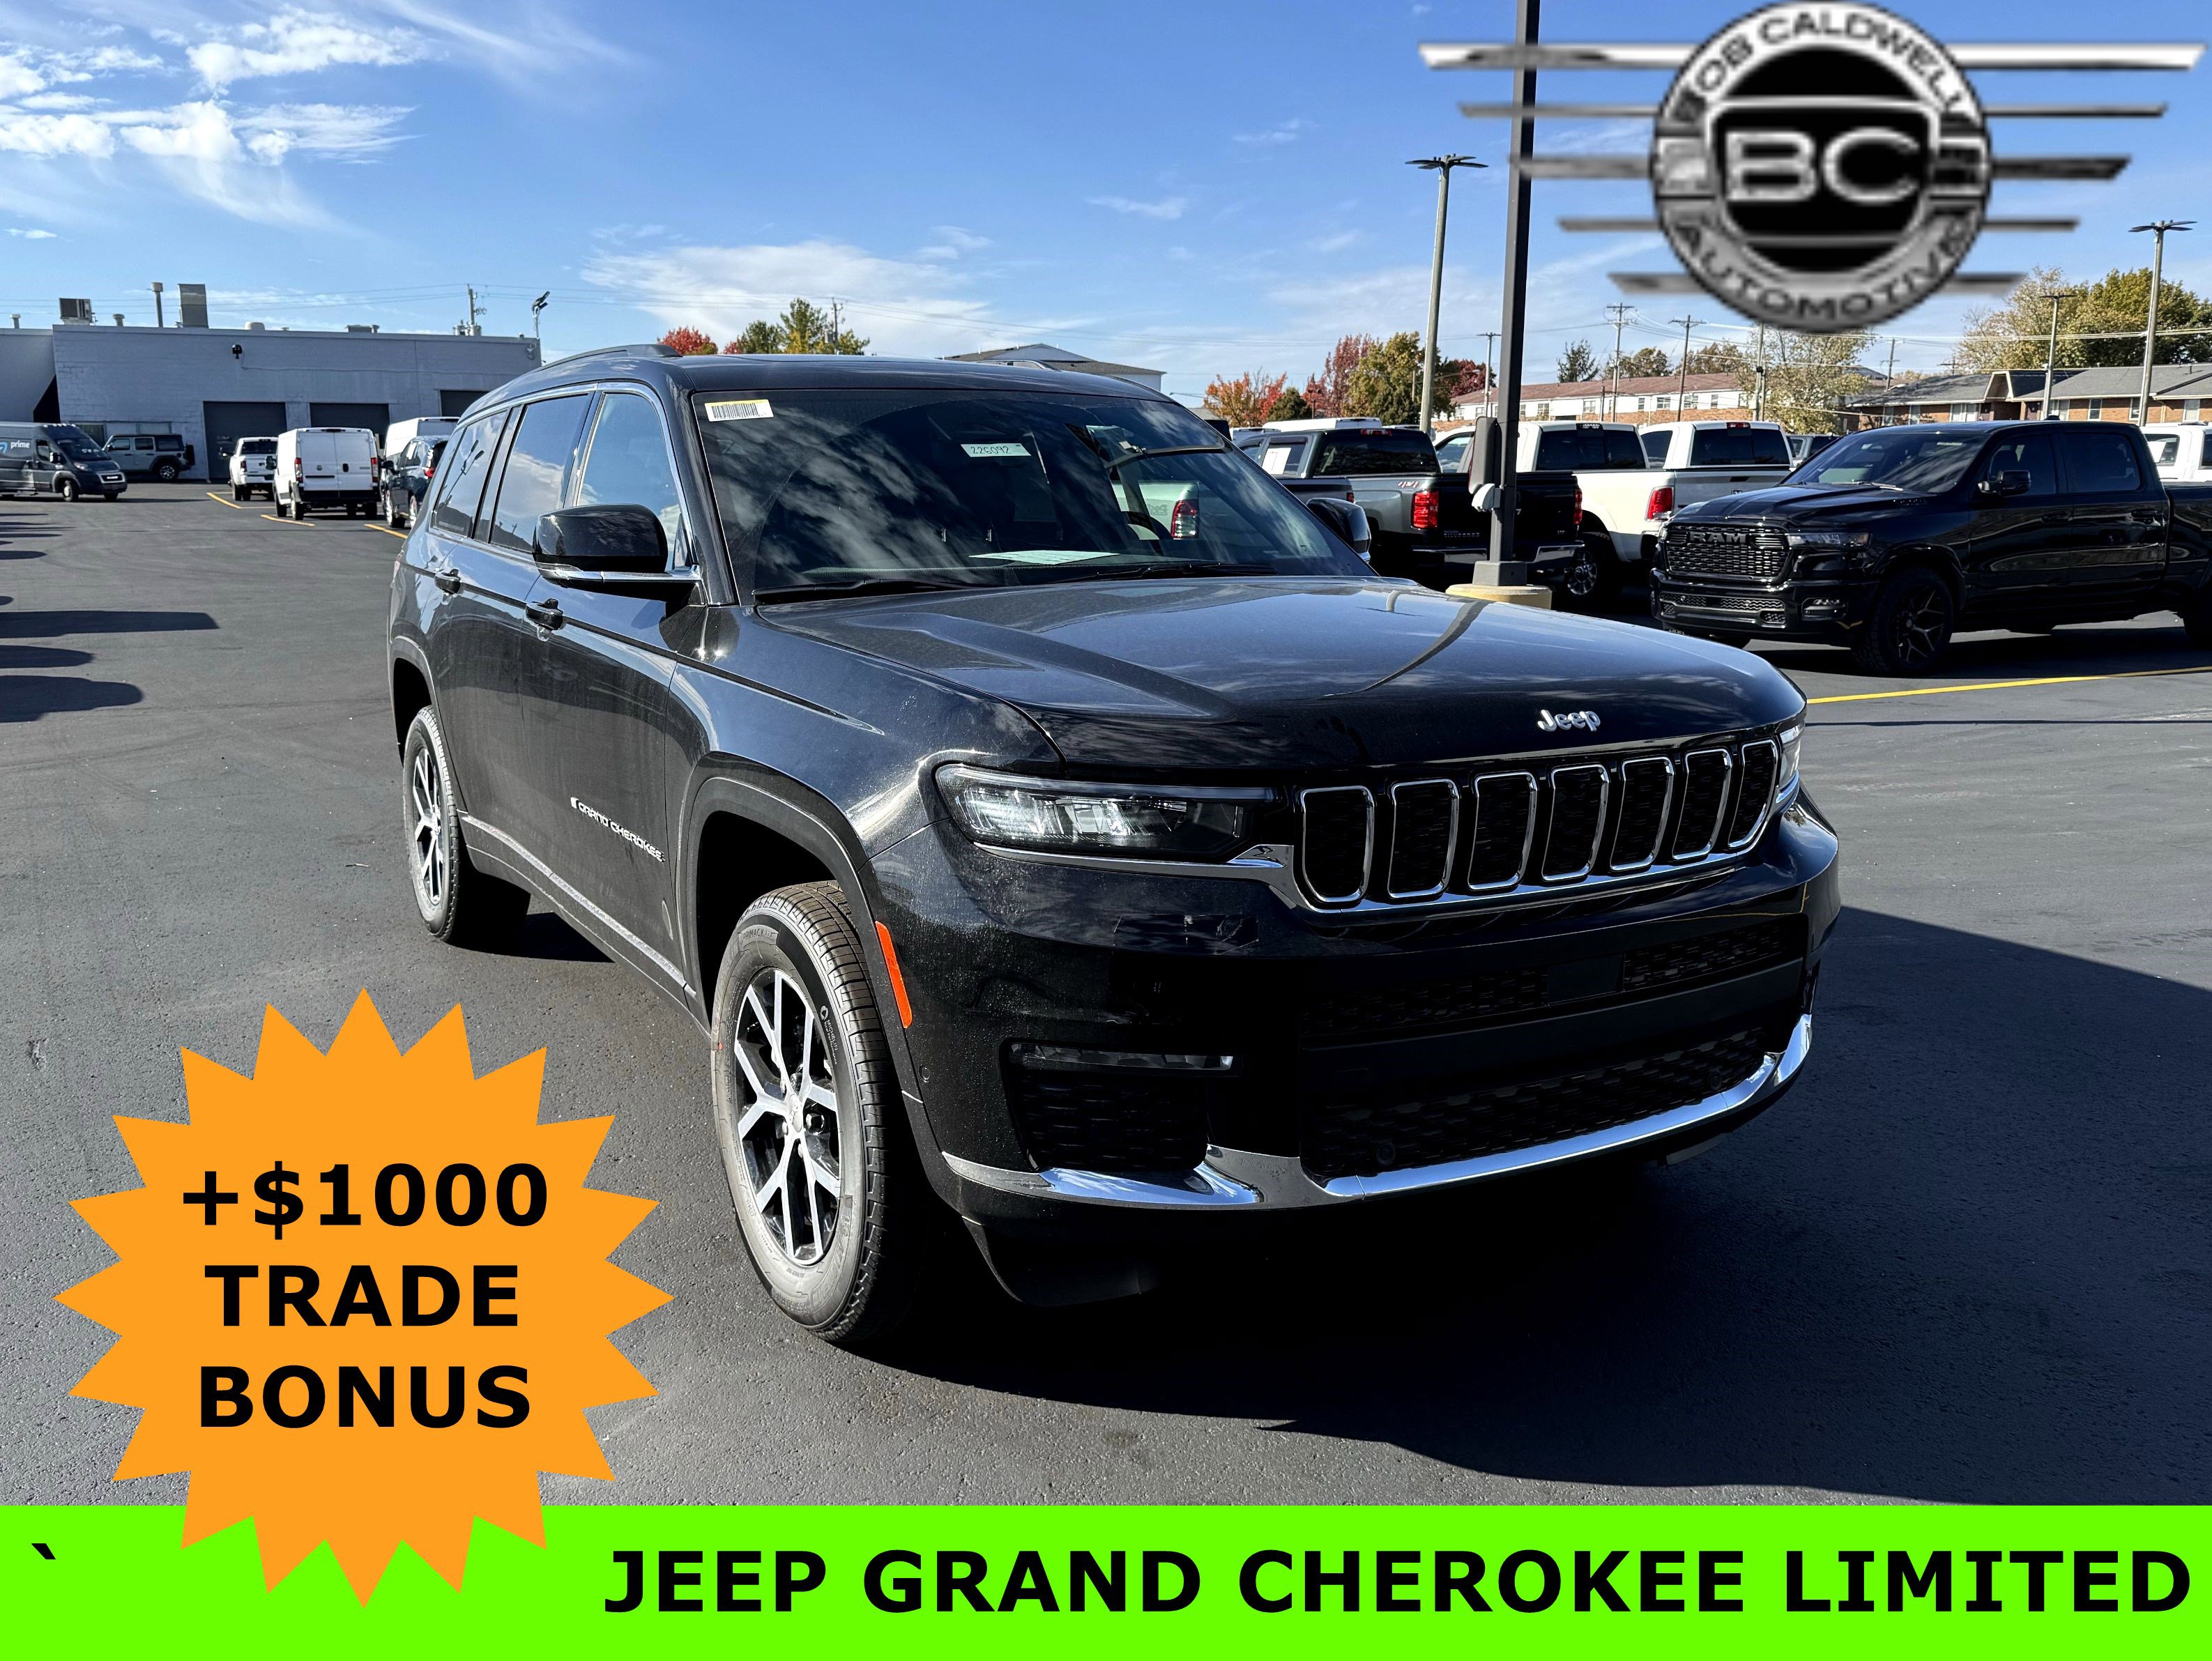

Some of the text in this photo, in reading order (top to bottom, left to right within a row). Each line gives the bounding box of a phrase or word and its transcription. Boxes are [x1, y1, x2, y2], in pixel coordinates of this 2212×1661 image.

[10, 440, 31, 450] prime
[1689, 531, 1747, 544] RAM
[1537, 709, 1601, 732] Jeep
[578, 802, 666, 863] GRAND CHEROKEE
